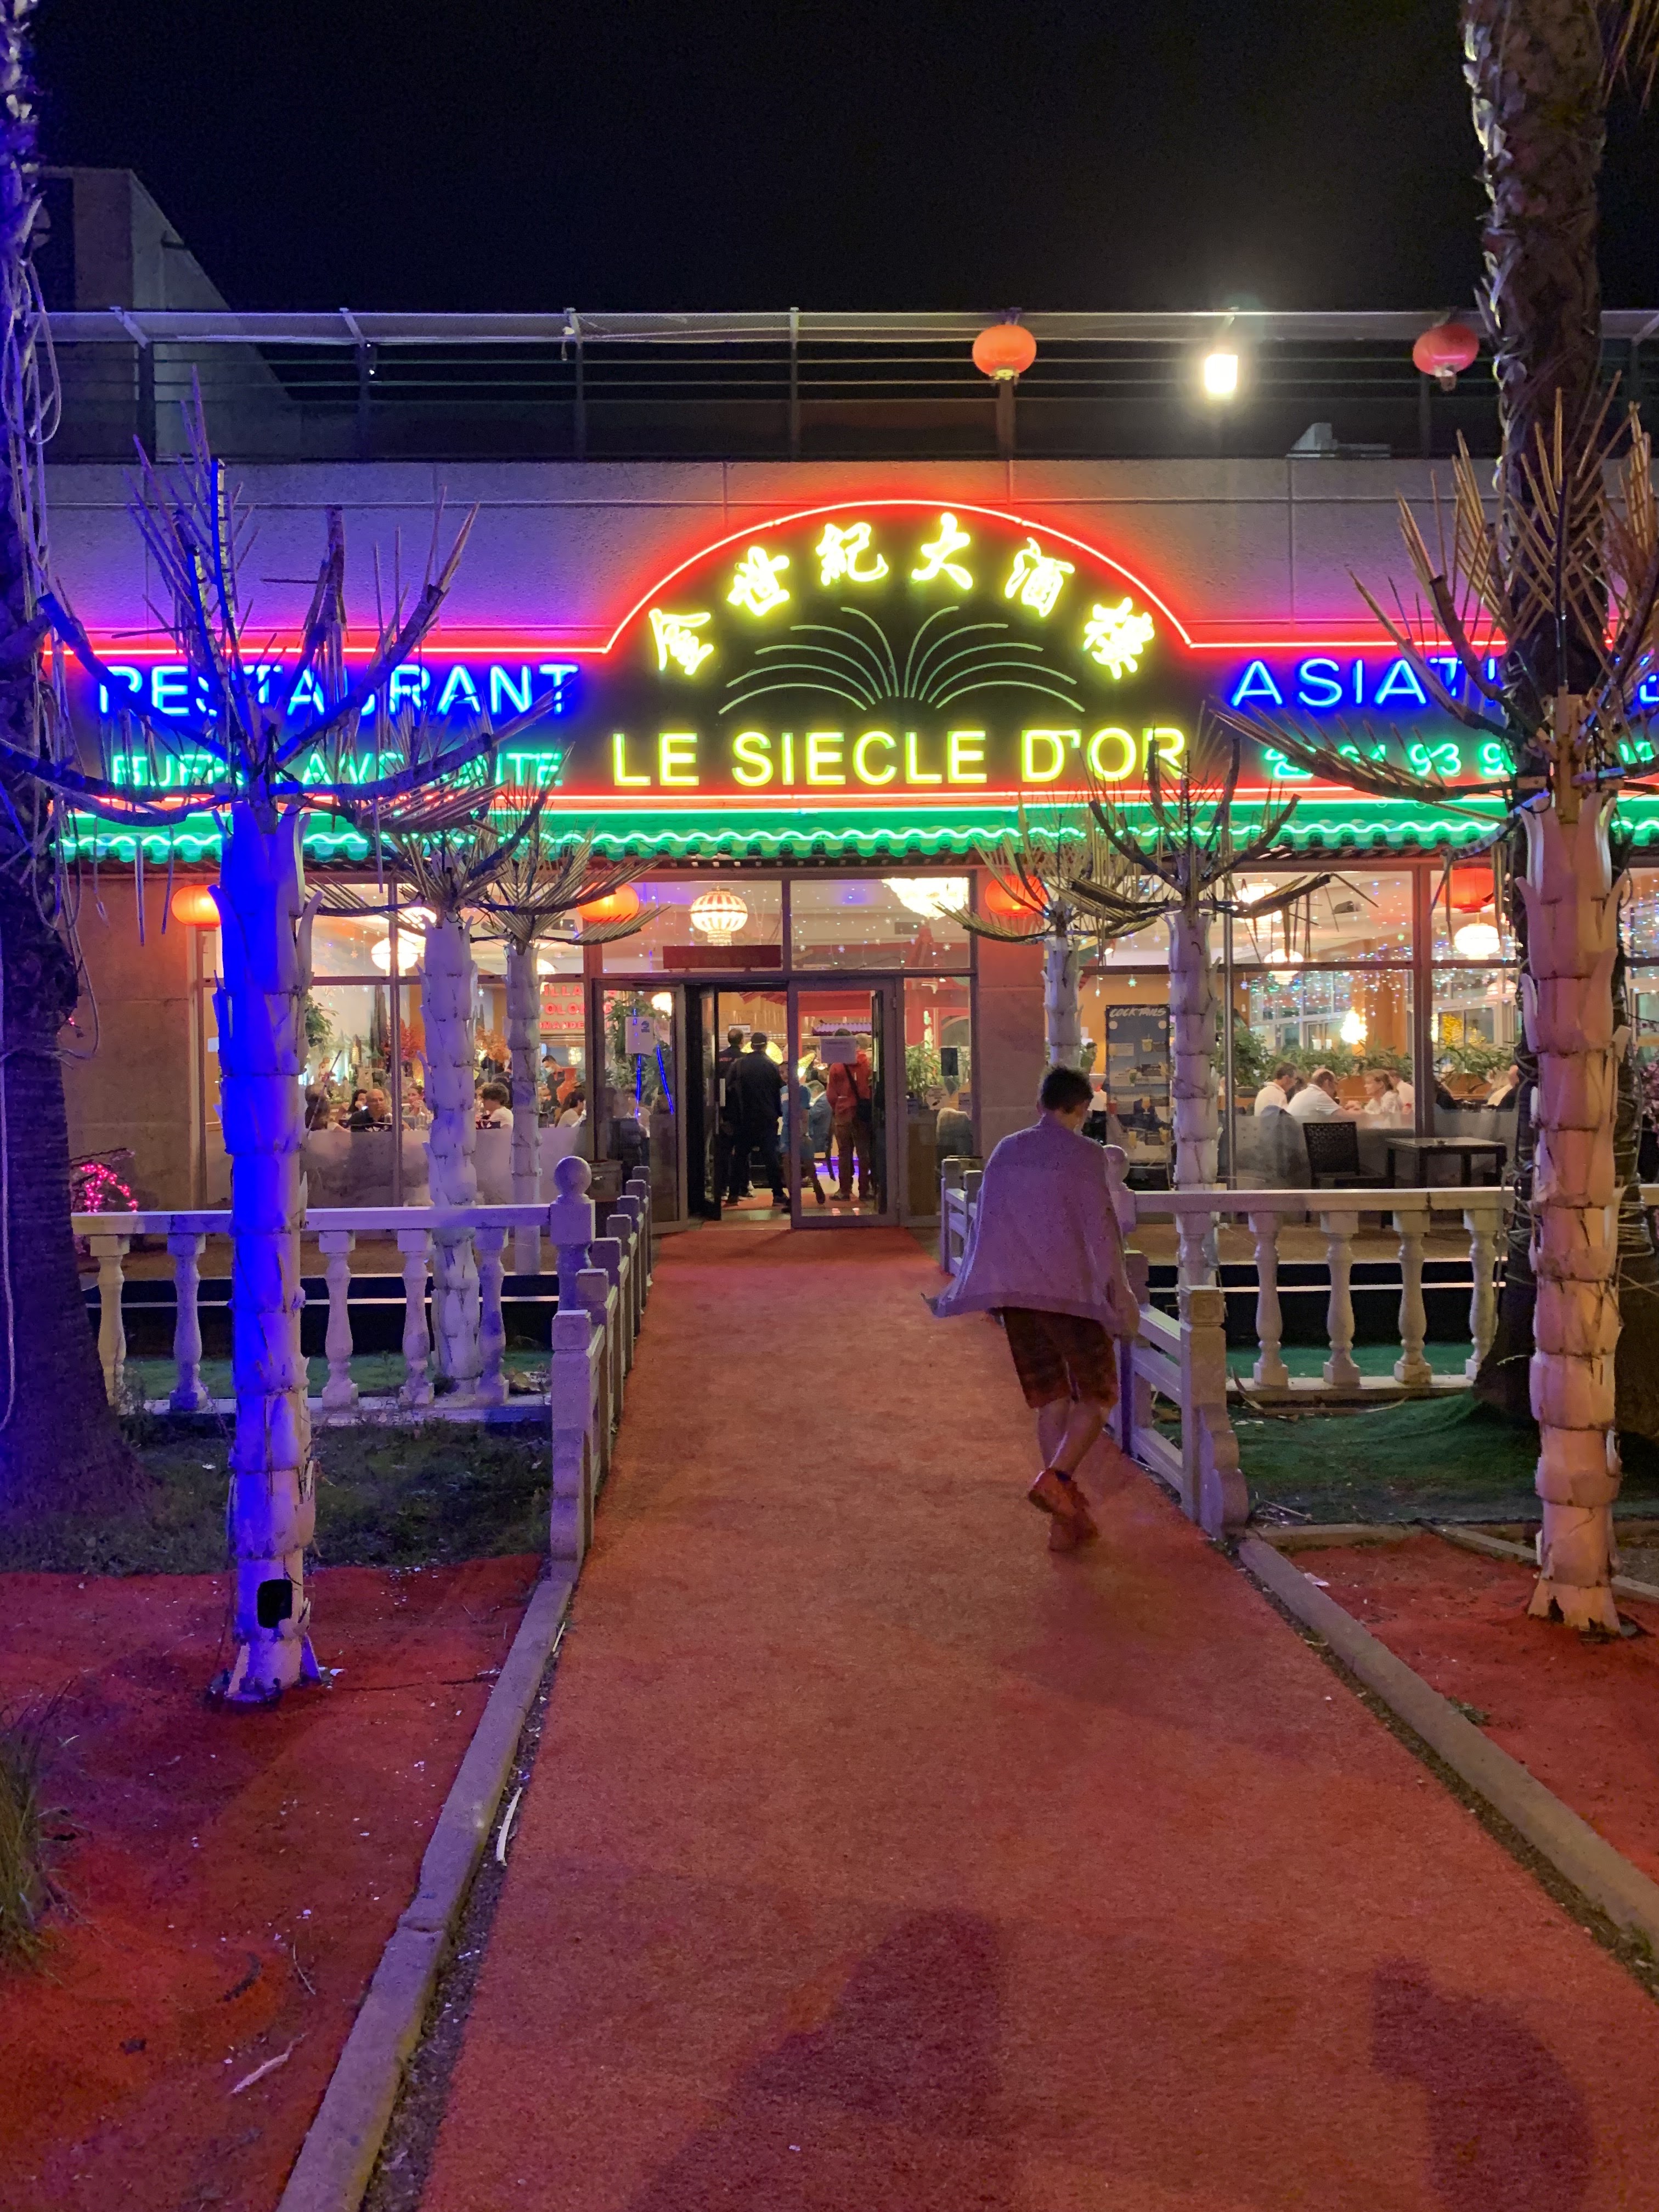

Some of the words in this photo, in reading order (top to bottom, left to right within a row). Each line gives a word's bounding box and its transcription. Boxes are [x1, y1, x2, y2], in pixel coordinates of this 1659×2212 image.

[1232, 657, 1659, 708] ASIATI
[613, 732, 699, 787] LE
[732, 730, 987, 786] SIECLE
[1021, 727, 1186, 783] D'OR
[1409, 743, 1461, 776] 93
